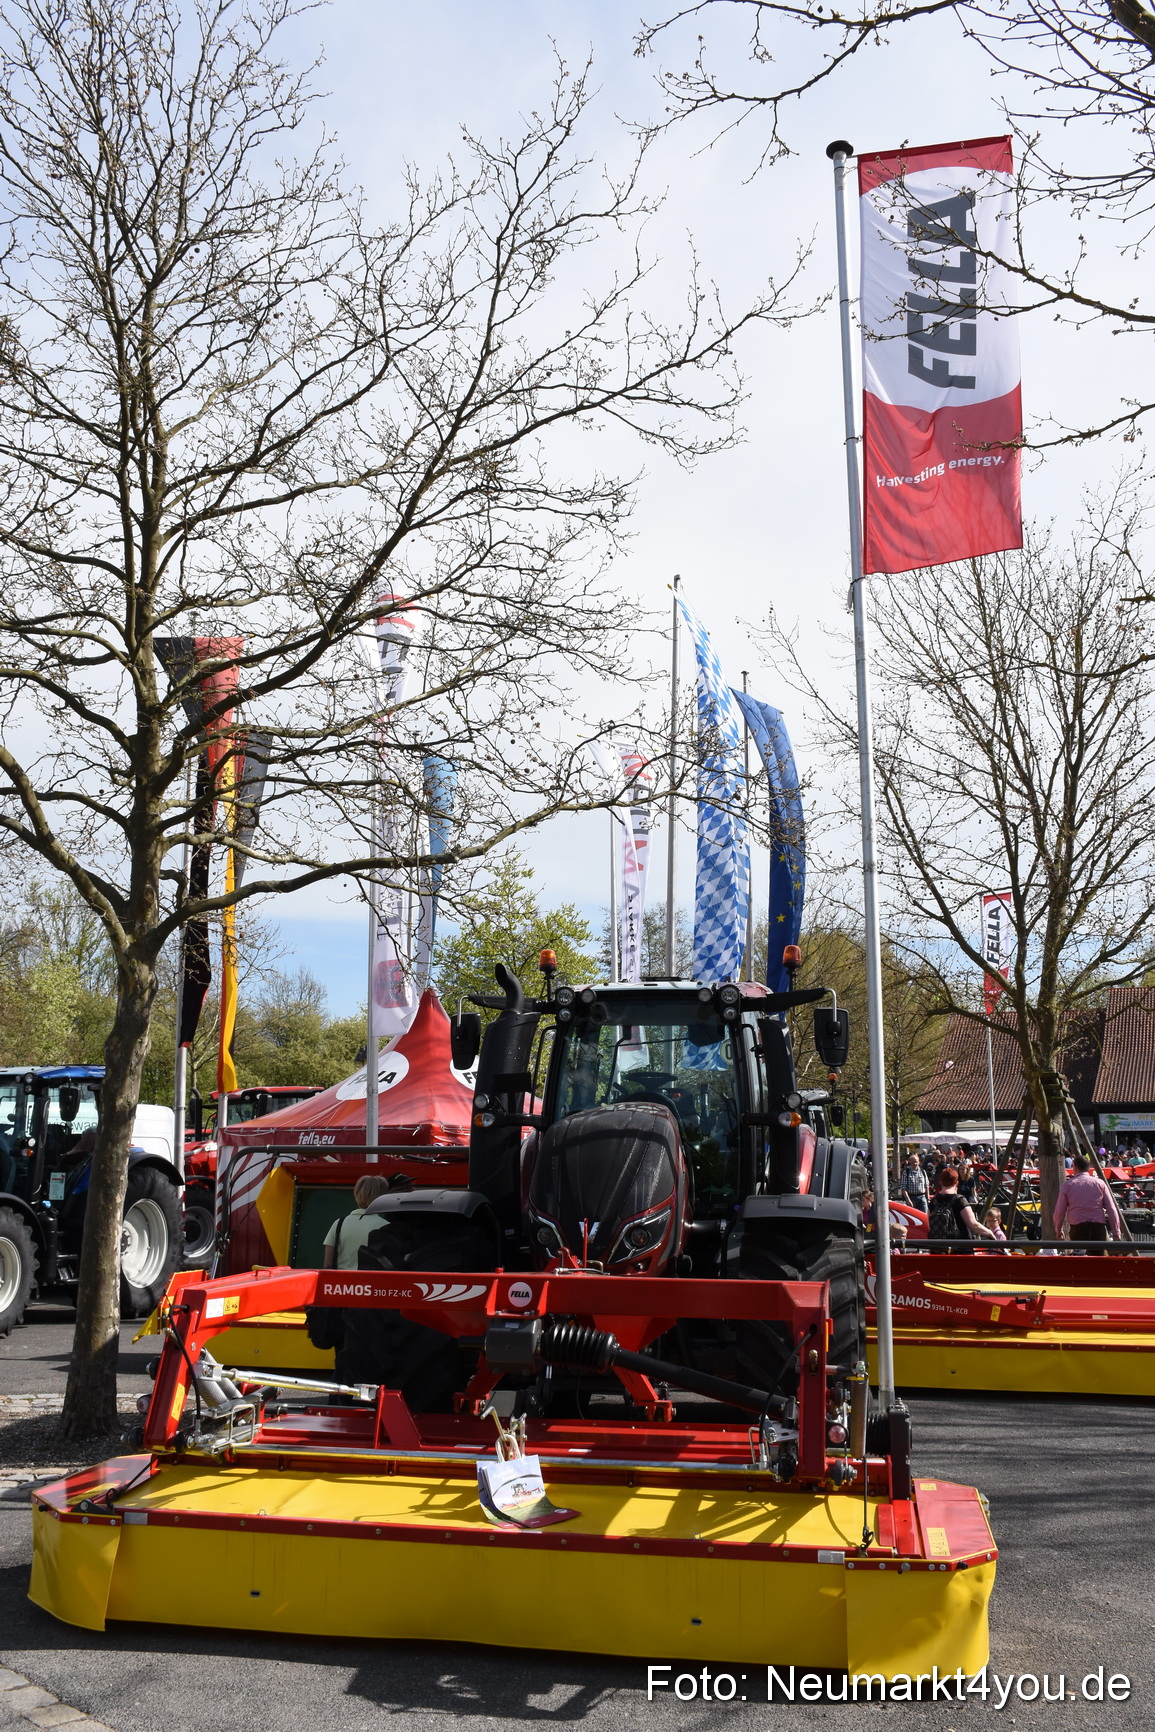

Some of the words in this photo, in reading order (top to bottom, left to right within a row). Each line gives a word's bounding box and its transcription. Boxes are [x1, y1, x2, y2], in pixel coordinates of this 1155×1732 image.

[907, 190, 977, 390] FELLA
[948, 455, 1005, 470] energy.
[986, 905, 1002, 966] FELLA
[298, 1131, 336, 1145] fella.eu
[323, 1283, 372, 1297] RAMOS
[373, 1288, 387, 1297] 310
[388, 1289, 412, 1298] FZ-KC
[510, 1290, 530, 1298] FELLA
[890, 1293, 932, 1309] RAMOS
[931, 1303, 945, 1311] 9314
